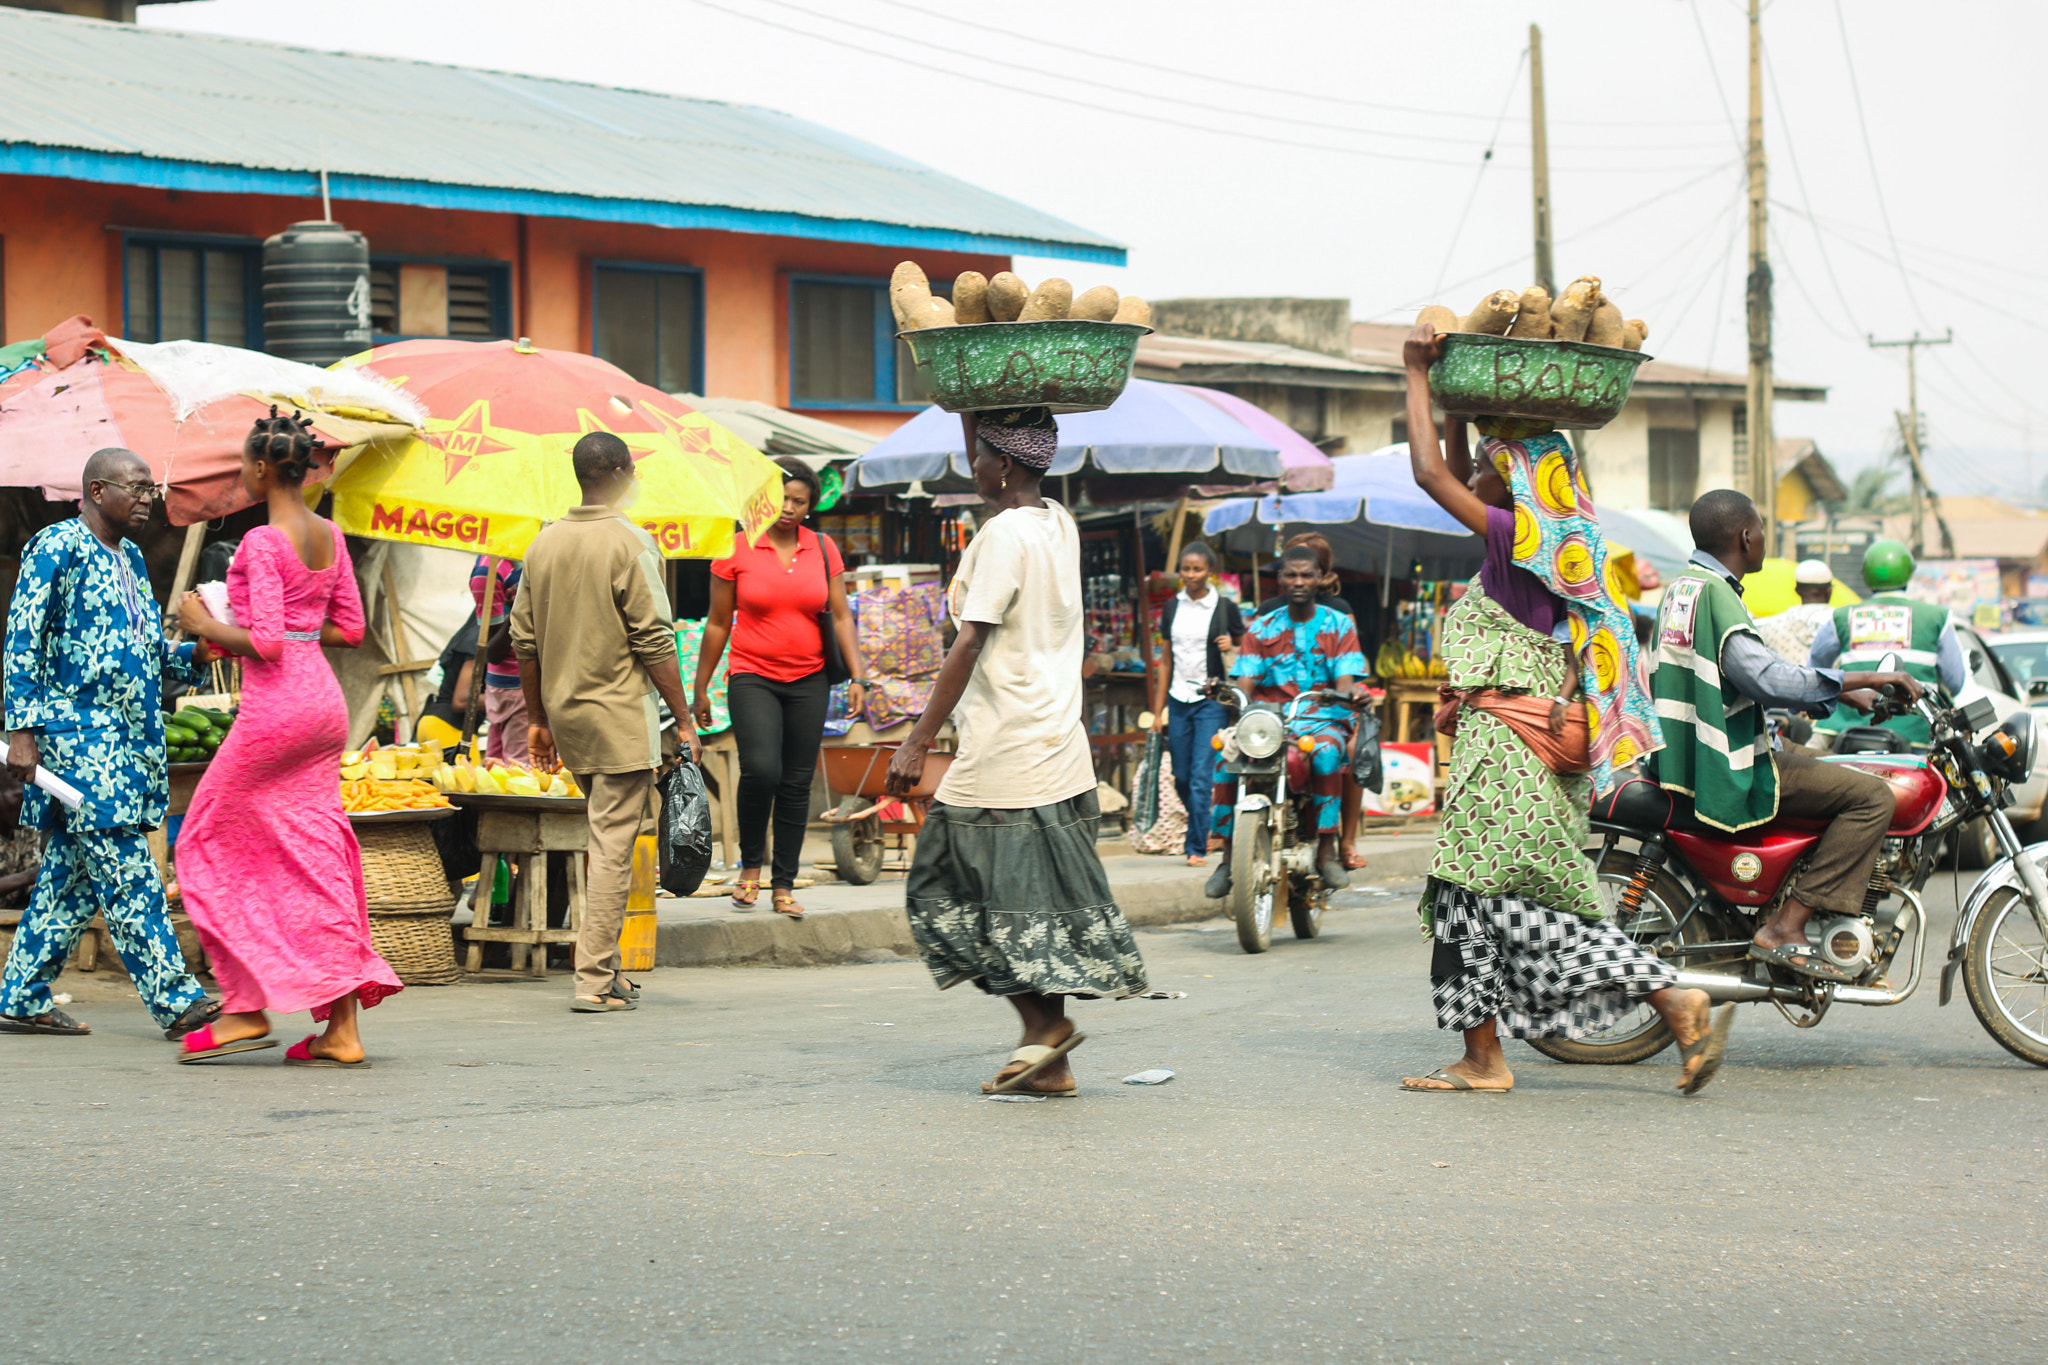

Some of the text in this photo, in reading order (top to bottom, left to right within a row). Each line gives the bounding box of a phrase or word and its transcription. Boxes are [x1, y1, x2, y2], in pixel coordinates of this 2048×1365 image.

[451, 434, 477, 452] M
[371, 503, 489, 545] MAGGI
[642, 521, 691, 550] GGI
